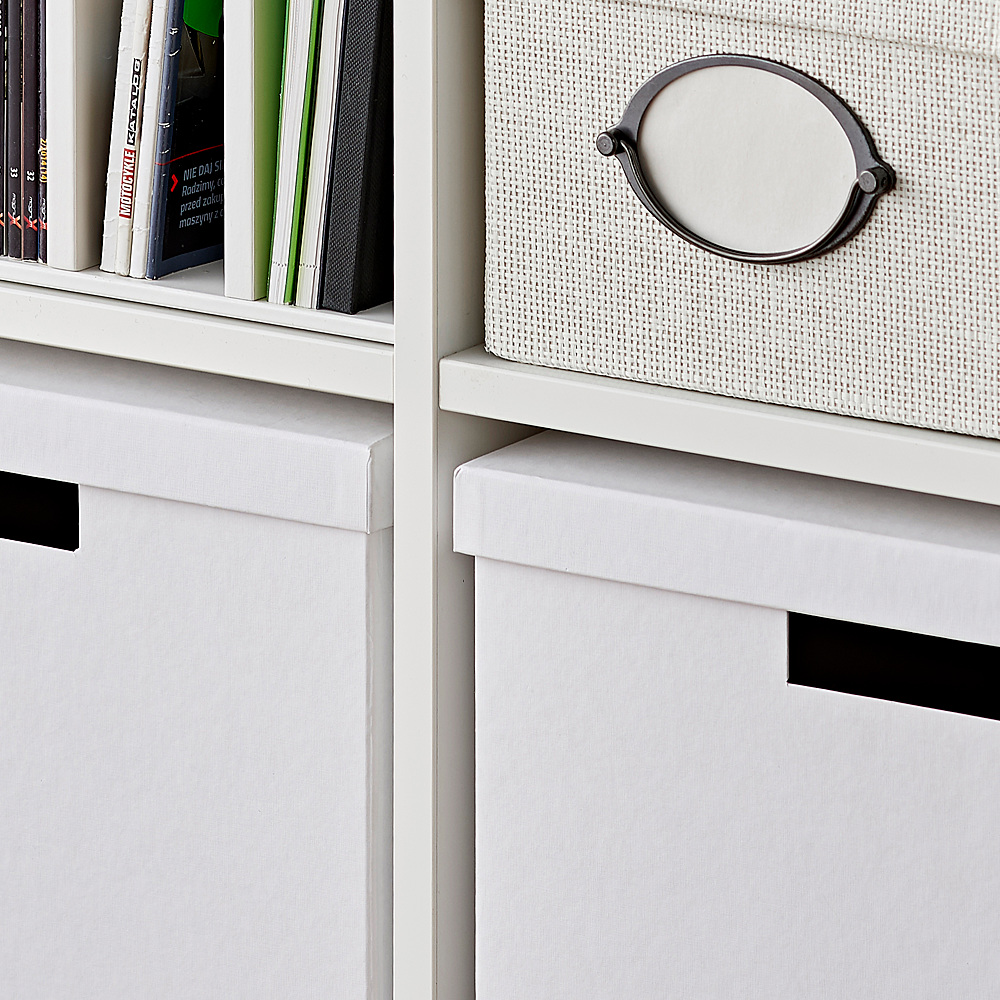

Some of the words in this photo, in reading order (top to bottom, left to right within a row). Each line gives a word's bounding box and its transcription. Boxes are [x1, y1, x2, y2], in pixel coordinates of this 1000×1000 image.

[120, 150, 136, 218] MOTOCYKLE
[128, 59, 141, 144] KATALOG
[184, 167, 197, 181] NIE
[198, 162, 212, 176] DAJ
[180, 196, 202, 216] przed
[179, 212, 213, 228] maszyny
